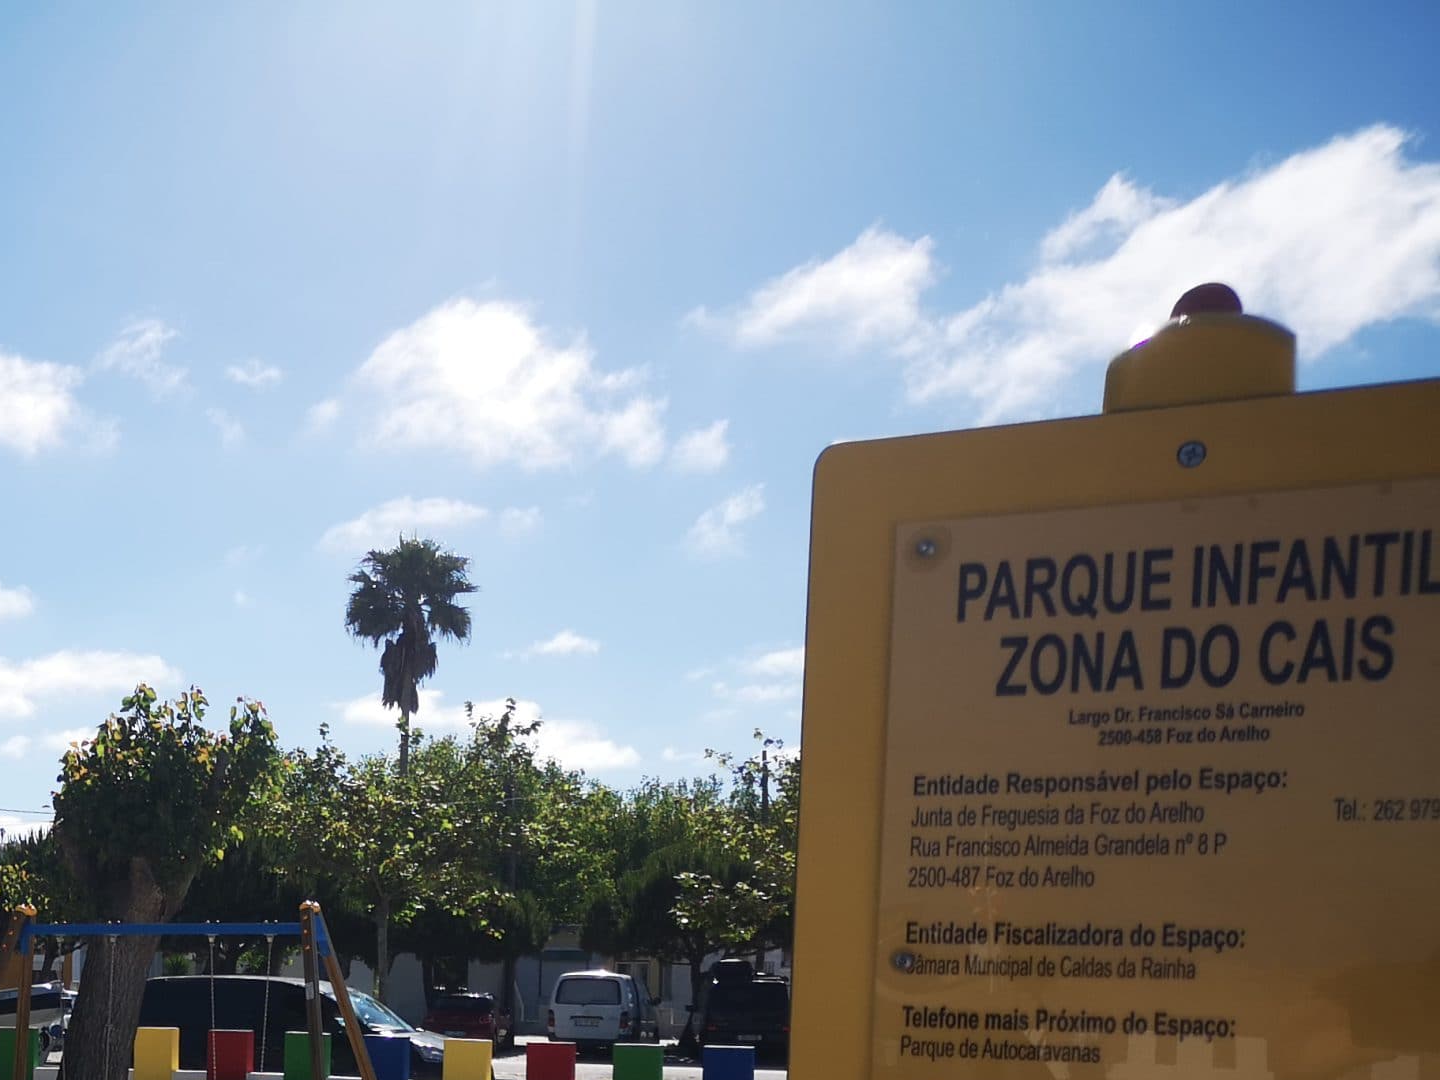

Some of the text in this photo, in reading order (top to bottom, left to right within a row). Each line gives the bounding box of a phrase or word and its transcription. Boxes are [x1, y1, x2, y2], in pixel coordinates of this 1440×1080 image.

[957, 529, 1440, 623] PARQUE INFANTIL
[996, 613, 1395, 697] ZONA DO CAIS
[1069, 709, 1109, 728] Largo
[1114, 707, 1134, 724] Dr.
[1138, 705, 1210, 722] Francisco
[1239, 701, 1305, 718] Carneiro
[1098, 725, 1270, 746] 2500-458 Foz do Arelho
[913, 767, 1288, 798] Entidade Responsável pelo Espaço:
[911, 801, 1205, 831] Junta de Freguesia da Foz do Arelho
[1334, 797, 1366, 822] Tel.:
[1373, 799, 1405, 821] 262
[910, 832, 1227, 857] Rua Francisco Almeida Grandela nº 8 P
[908, 865, 1095, 888] 2500-487 Foz do Arelho
[906, 921, 1245, 952] Entidade Fiscalizadora do Espaço:
[964, 955, 1032, 981] Municipal
[1037, 956, 1055, 977] de
[1060, 956, 1112, 978] Caldas
[1117, 957, 1136, 978] da
[1141, 957, 1196, 980] Rainha
[902, 1005, 1236, 1043] Telefone mais Próximo do Espaço:
[900, 1035, 1101, 1063] Parque de Autocaravanas
